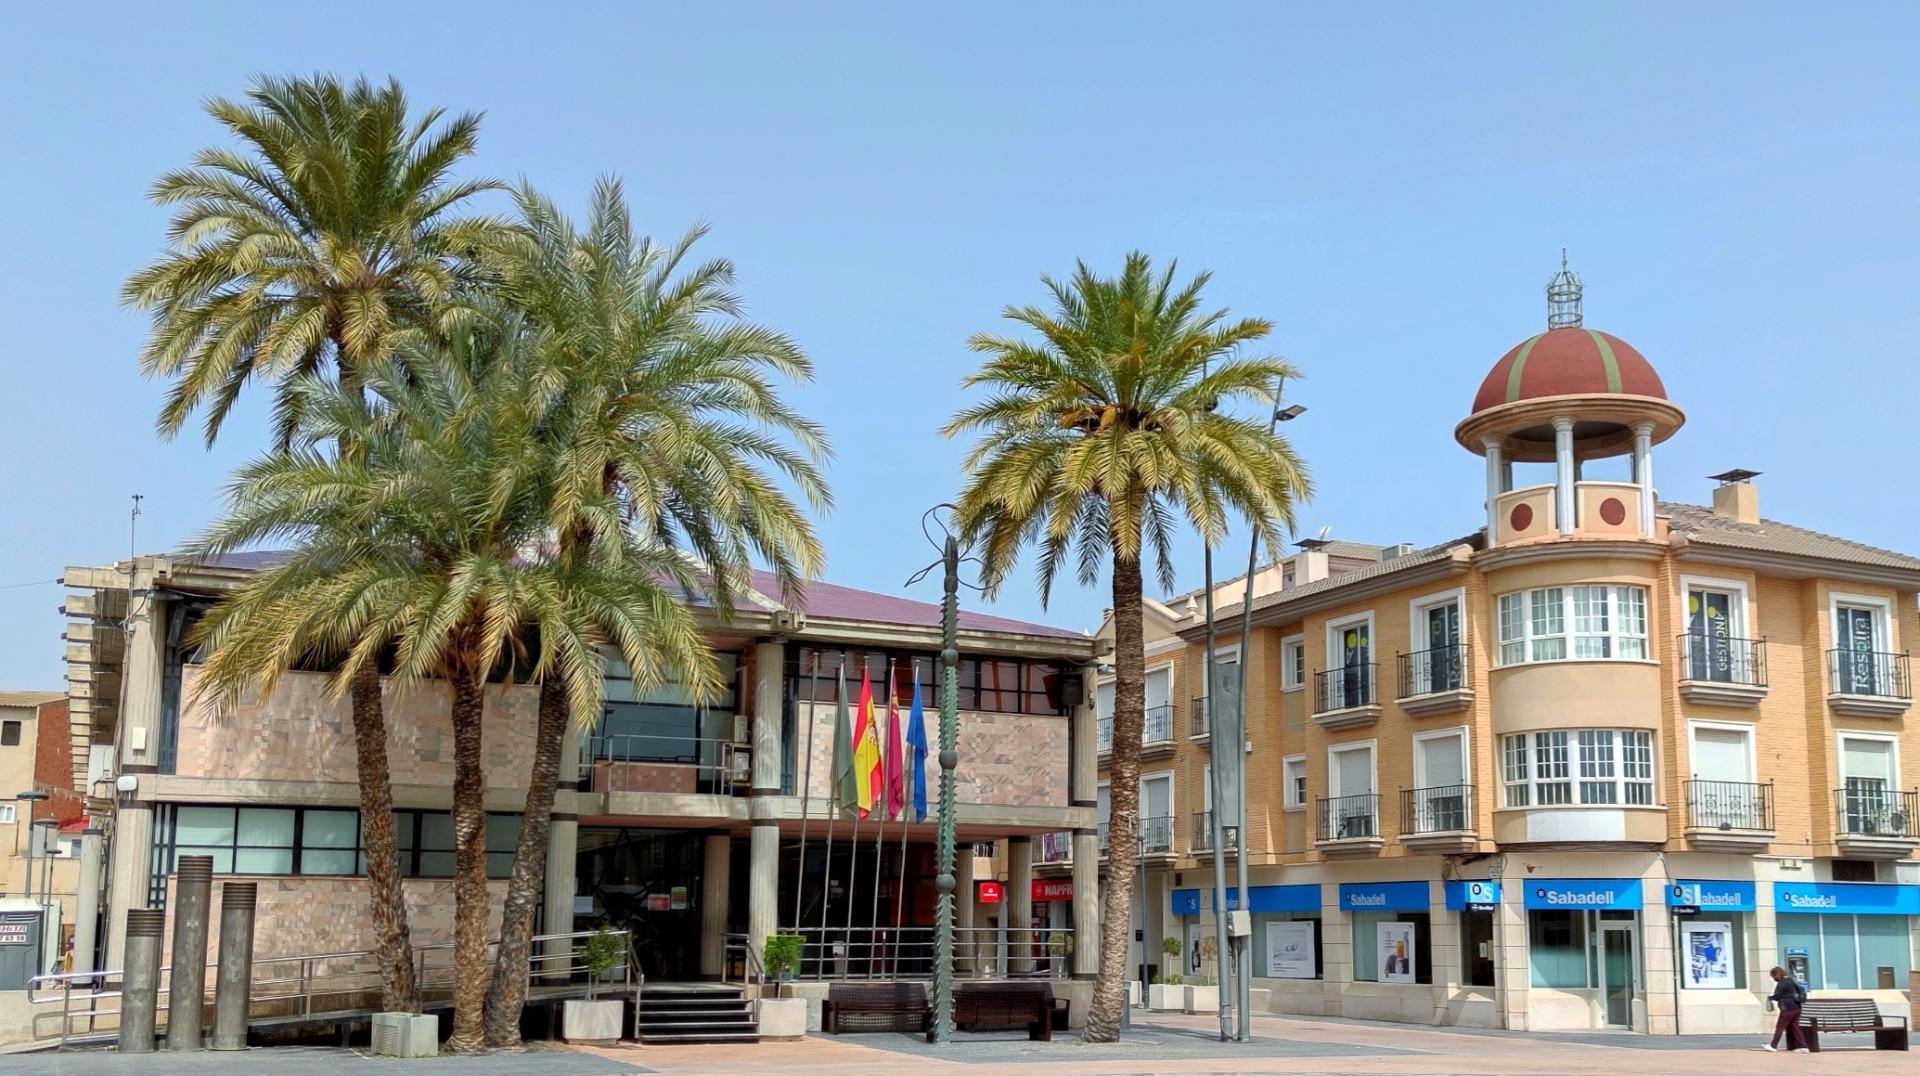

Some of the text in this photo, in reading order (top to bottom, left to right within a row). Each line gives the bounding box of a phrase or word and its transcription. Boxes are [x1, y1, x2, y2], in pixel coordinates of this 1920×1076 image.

[1045, 884, 1073, 896] MAPFR
[1351, 893, 1386, 906] Sabadell
[1547, 891, 1614, 905] Sabadell
[1701, 892, 1742, 906] abadell
[1790, 894, 1837, 908] Sabadell
